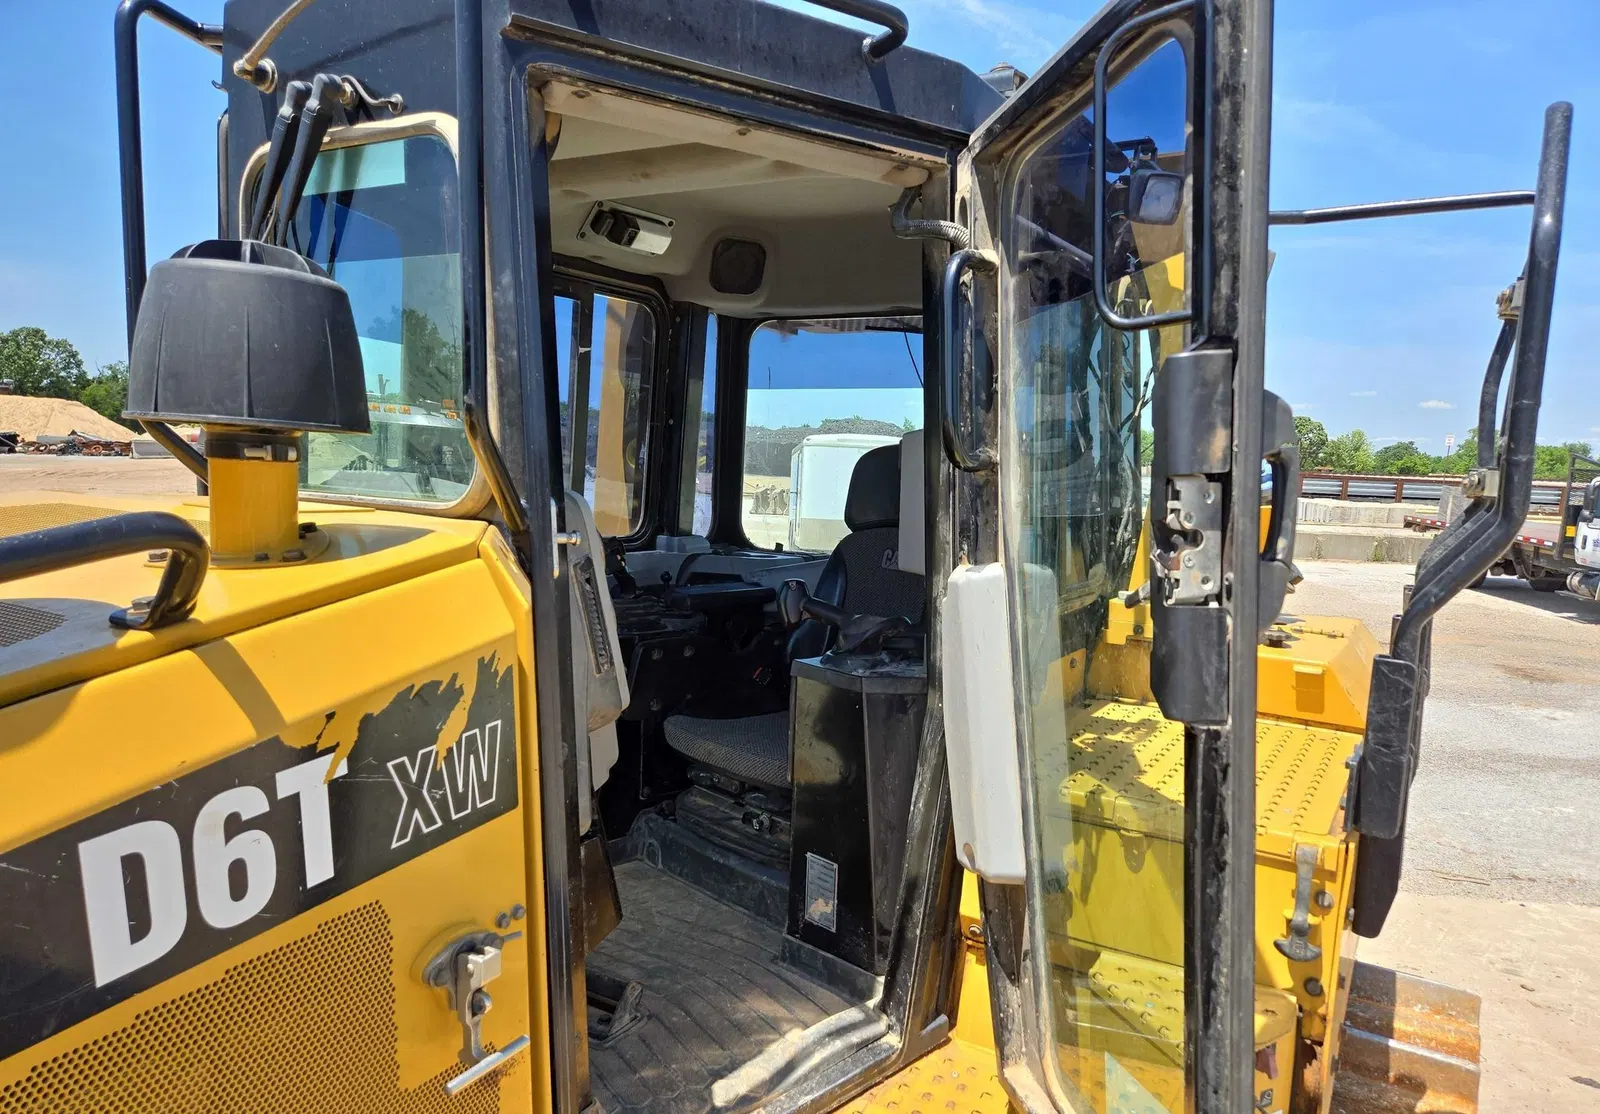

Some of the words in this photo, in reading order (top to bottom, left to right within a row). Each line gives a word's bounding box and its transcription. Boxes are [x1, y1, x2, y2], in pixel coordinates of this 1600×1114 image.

[881, 549, 900, 570] CA
[78, 752, 348, 989] D6T
[386, 719, 502, 849] XW
